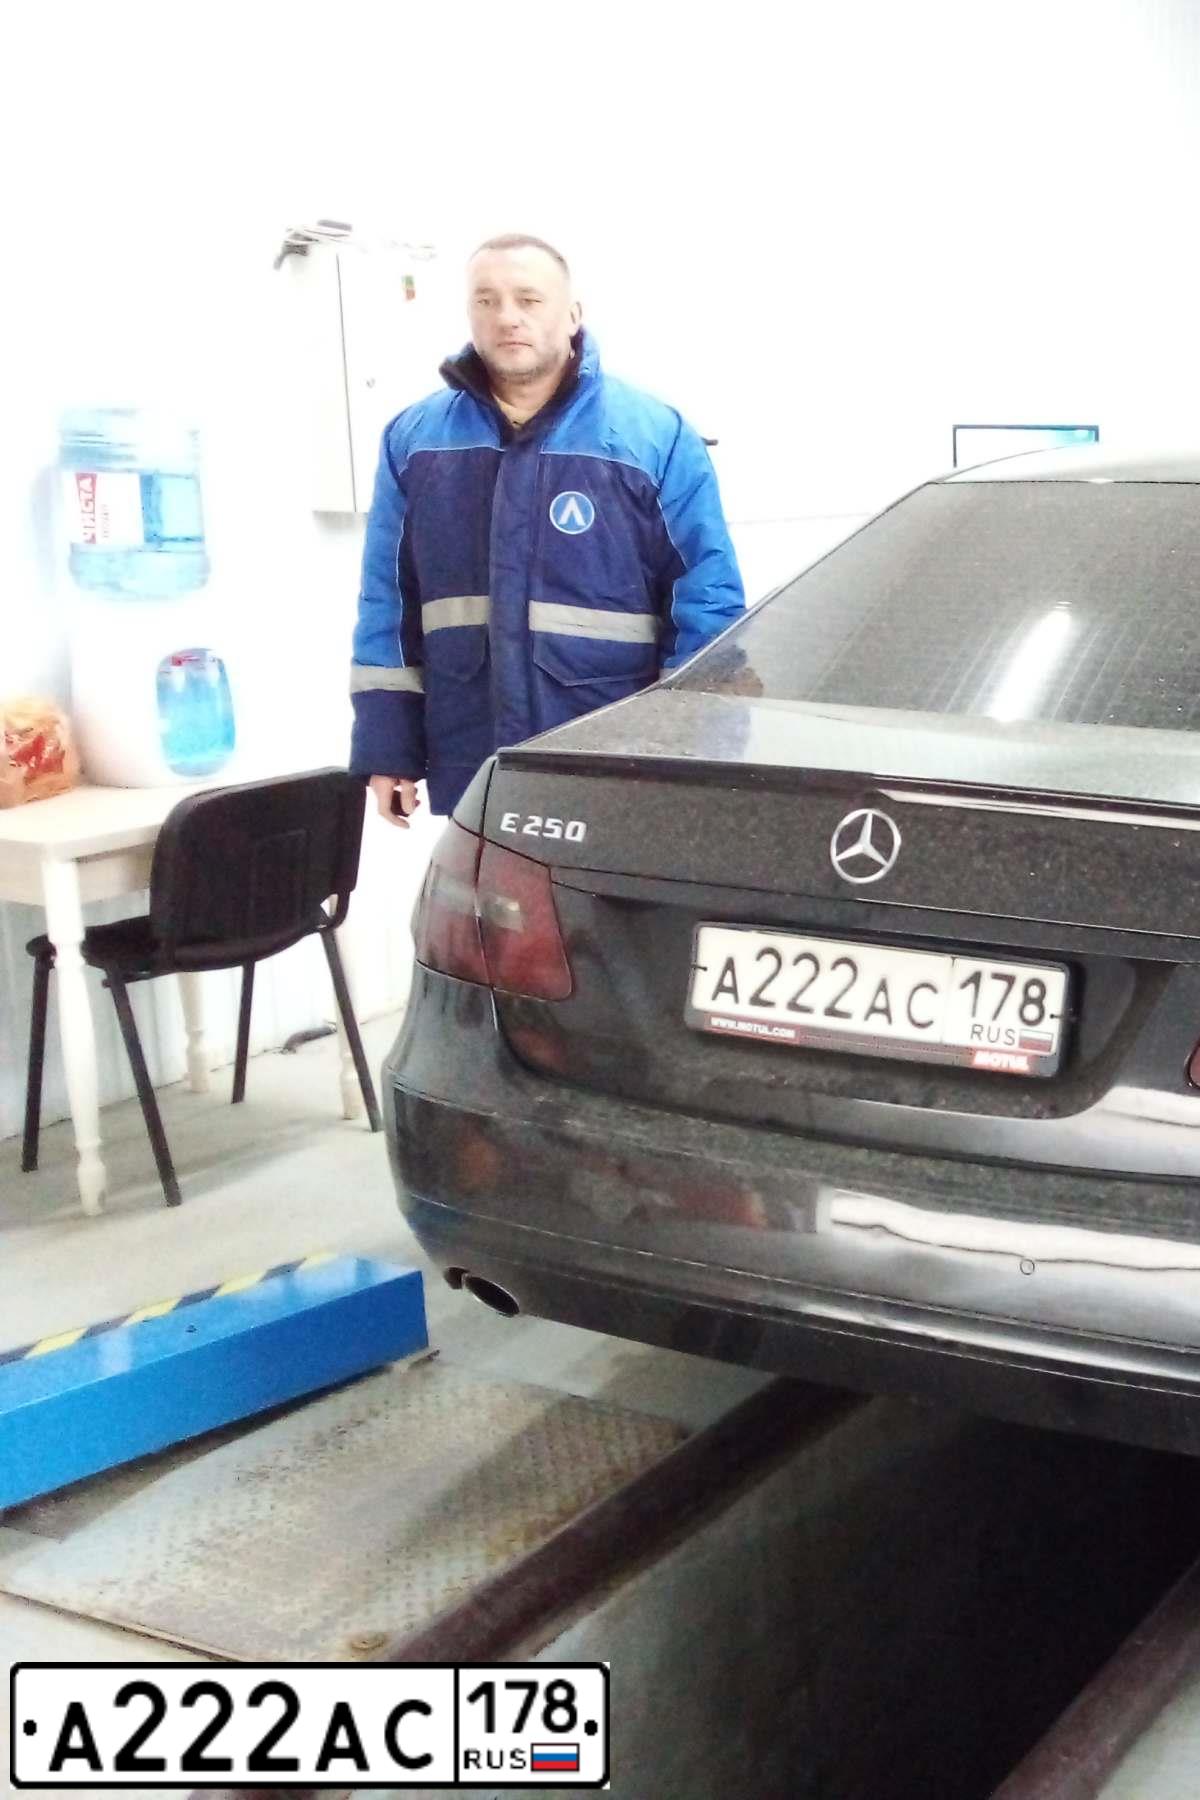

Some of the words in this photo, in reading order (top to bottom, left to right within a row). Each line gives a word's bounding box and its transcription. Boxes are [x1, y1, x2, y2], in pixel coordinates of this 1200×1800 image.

[500, 812, 520, 833] E
[522, 815, 587, 842] 250
[959, 970, 1047, 1027] 178
[970, 1023, 1017, 1046] RUS
